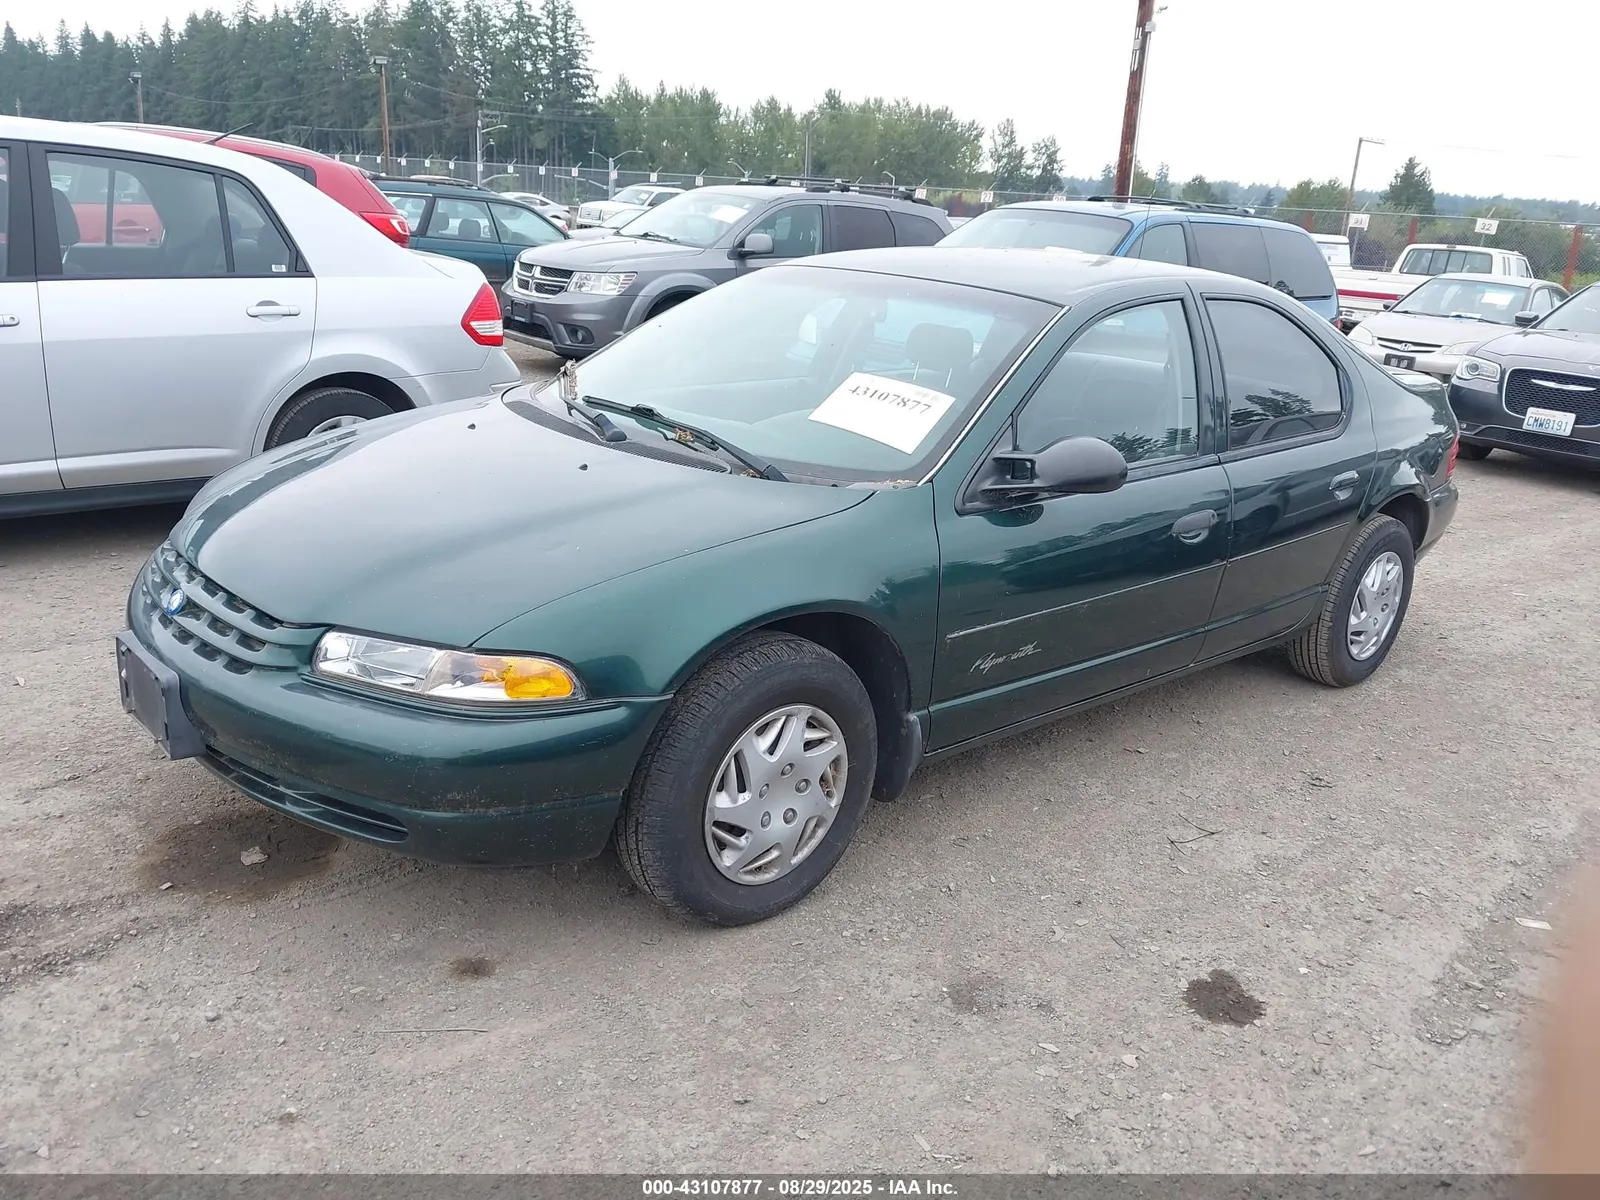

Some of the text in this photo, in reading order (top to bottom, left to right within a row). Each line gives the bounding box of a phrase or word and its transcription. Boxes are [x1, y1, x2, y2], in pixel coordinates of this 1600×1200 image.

[982, 191, 993, 201] 27
[1353, 217, 1363, 225] 31
[1481, 222, 1493, 231] 32
[848, 384, 932, 414] 43107877
[1526, 415, 1569, 433] CMW8191
[968, 640, 1042, 675] Plymouth
